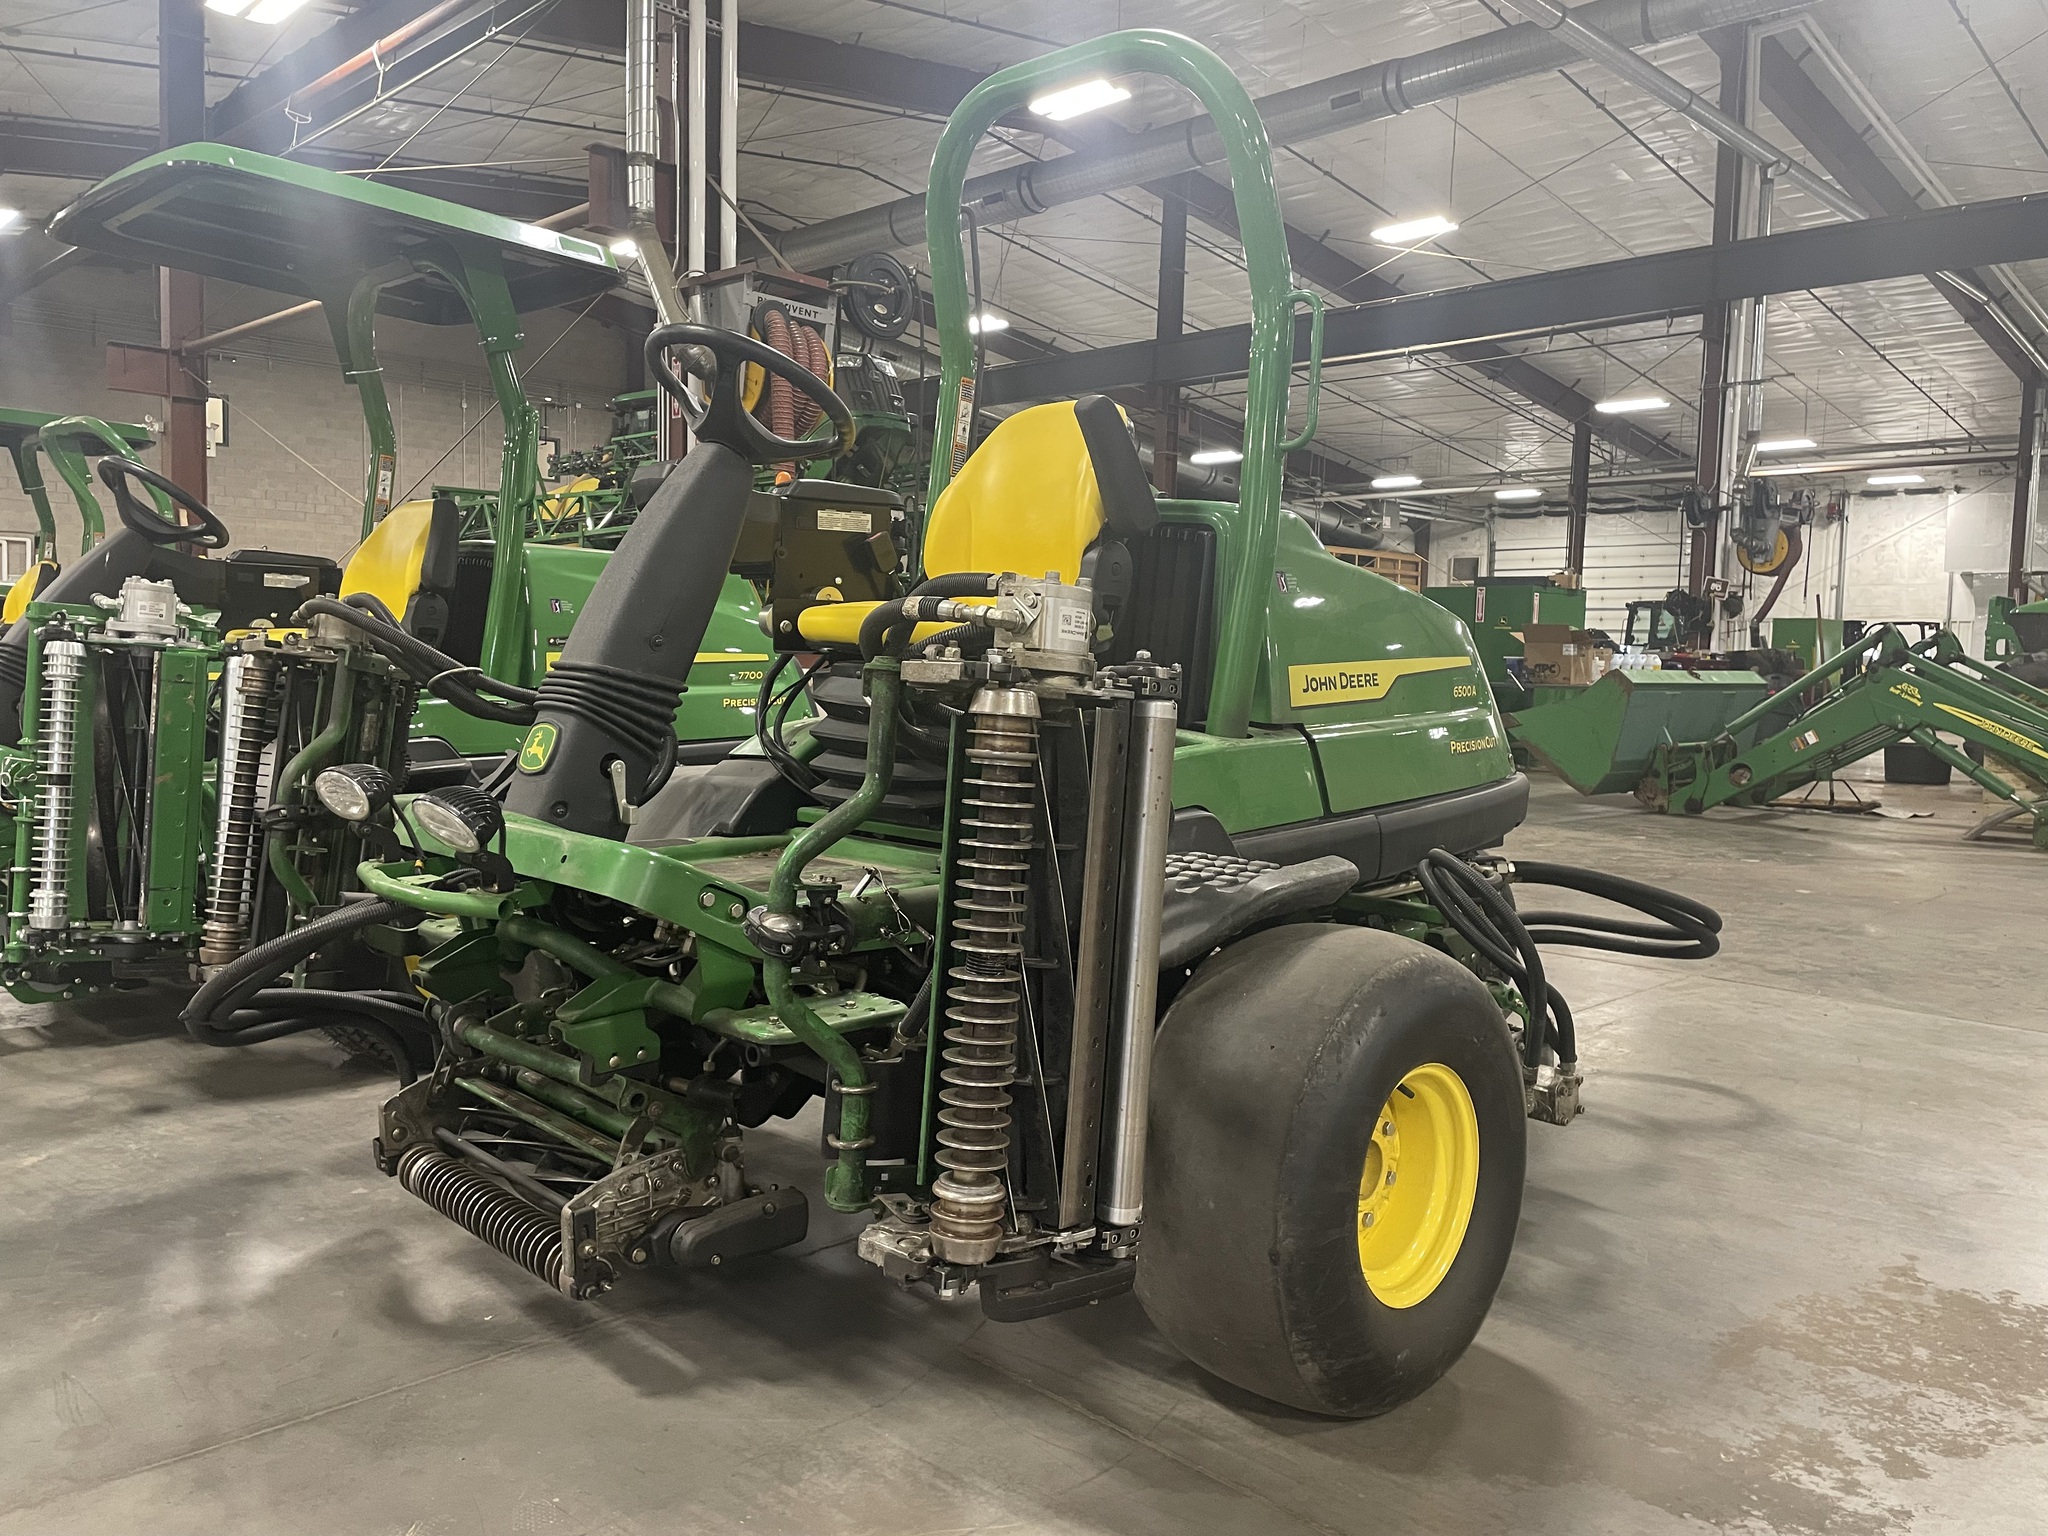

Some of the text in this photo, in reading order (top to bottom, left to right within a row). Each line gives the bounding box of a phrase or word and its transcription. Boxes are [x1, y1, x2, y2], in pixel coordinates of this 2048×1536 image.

[757, 296, 819, 319] PVENT
[1303, 672, 1379, 693] JOHN DEERE
[723, 696, 787, 708] PRECISCUT
